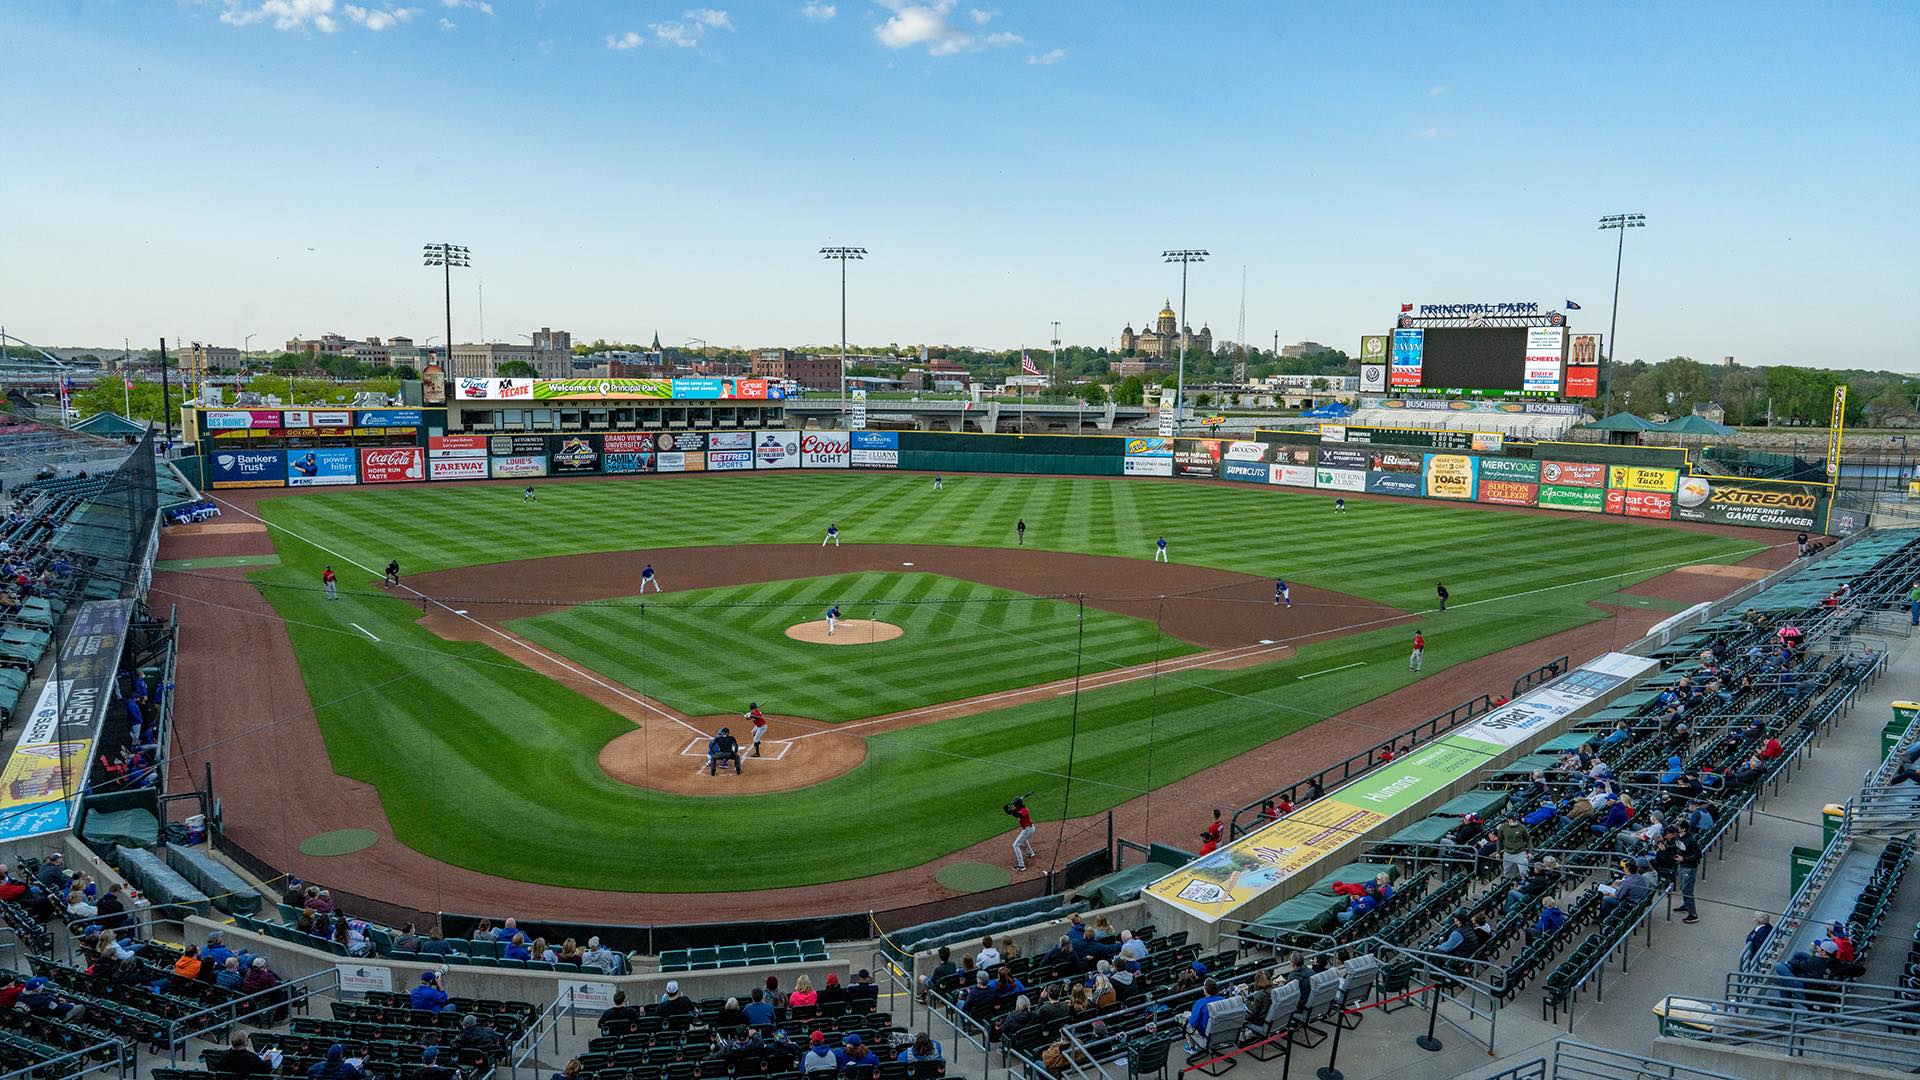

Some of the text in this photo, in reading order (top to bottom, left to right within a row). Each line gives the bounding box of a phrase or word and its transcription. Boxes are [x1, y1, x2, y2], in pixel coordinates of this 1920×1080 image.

[1421, 302, 1537, 314] PRINCIPAL PARK
[461, 378, 489, 389] Ford
[611, 384, 640, 393] Principal
[740, 381, 762, 390] Great
[501, 386, 528, 398] TECATE
[742, 388, 762, 397] Clips
[208, 418, 246, 427] DES MOINES
[802, 436, 849, 454] Coors
[606, 454, 636, 463] FAMILY
[810, 454, 841, 463] LIGHT
[435, 463, 483, 471] FAREWAY
[1227, 466, 1264, 476] SUPERCUTS
[1482, 461, 1536, 472] MERCYONE
[1435, 476, 1467, 484] TOAST
[1488, 484, 1528, 492] SIMPSON
[1487, 490, 1528, 499] COLLEGE
[1713, 488, 1815, 508] XTREAM
[1608, 493, 1672, 508] Great Clips
[1743, 507, 1785, 515] INTERNET
[1727, 513, 1813, 526] GAME CHANGER
[60, 687, 98, 727] RAMSEY
[1482, 708, 1535, 729] Smart
[1362, 775, 1421, 803] Humana
